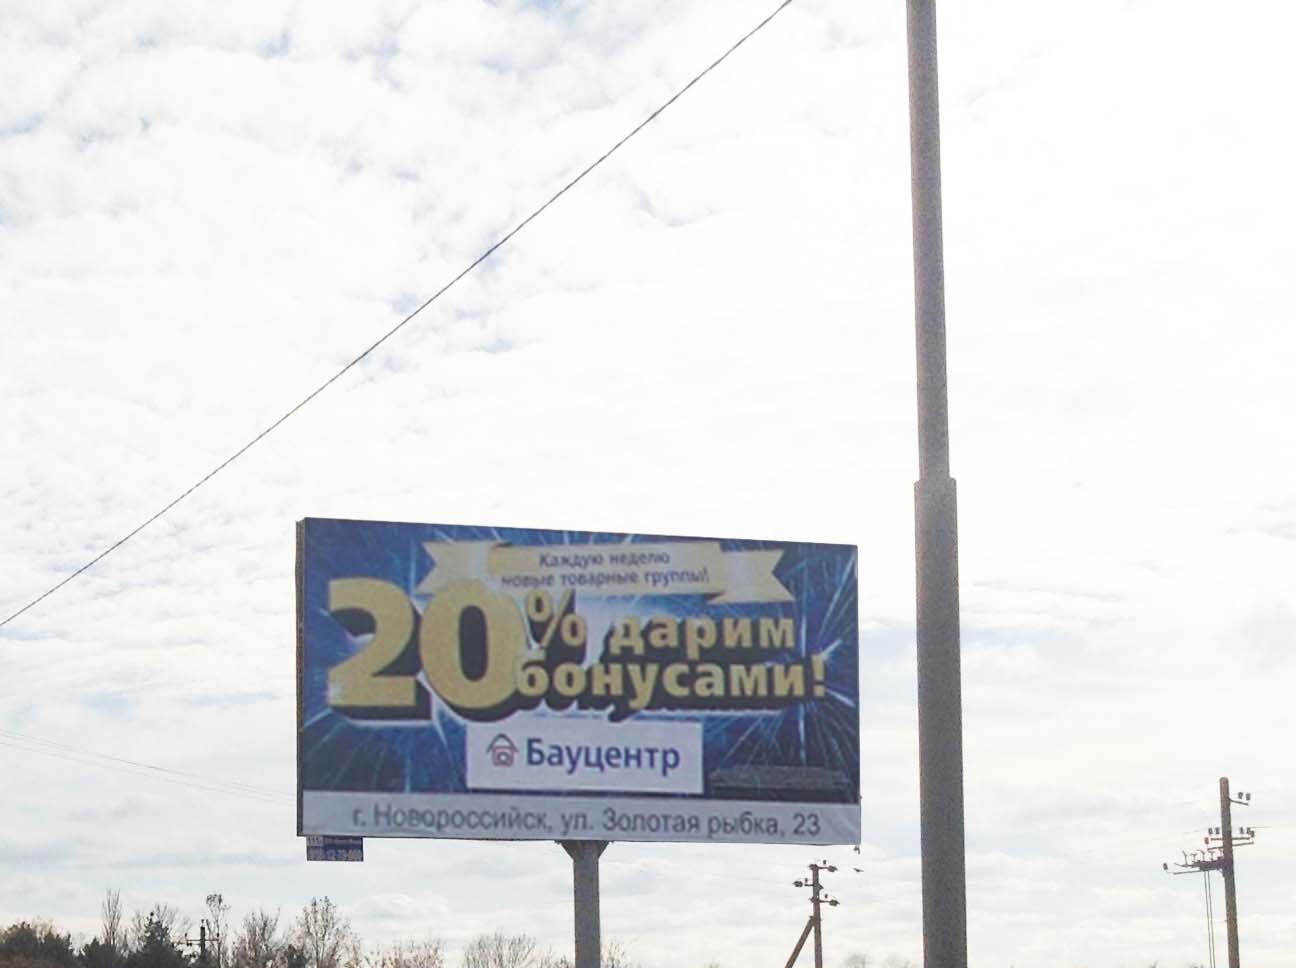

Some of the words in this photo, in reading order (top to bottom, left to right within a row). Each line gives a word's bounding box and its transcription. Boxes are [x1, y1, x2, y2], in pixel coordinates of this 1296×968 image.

[539, 552, 603, 569] Каждую
[609, 550, 670, 566] неделю
[501, 575, 554, 588] новые
[561, 572, 639, 589] товарные
[609, 614, 796, 661] дарим
[515, 649, 826, 710] бонусами!
[526, 737, 681, 777] Бауцентр
[352, 809, 366, 827] г.
[373, 803, 553, 833] Новороссийск,
[561, 812, 594, 837] ул.
[602, 807, 700, 832] Золотая
[707, 810, 785, 839] рыбка,
[793, 812, 822, 837] 23
